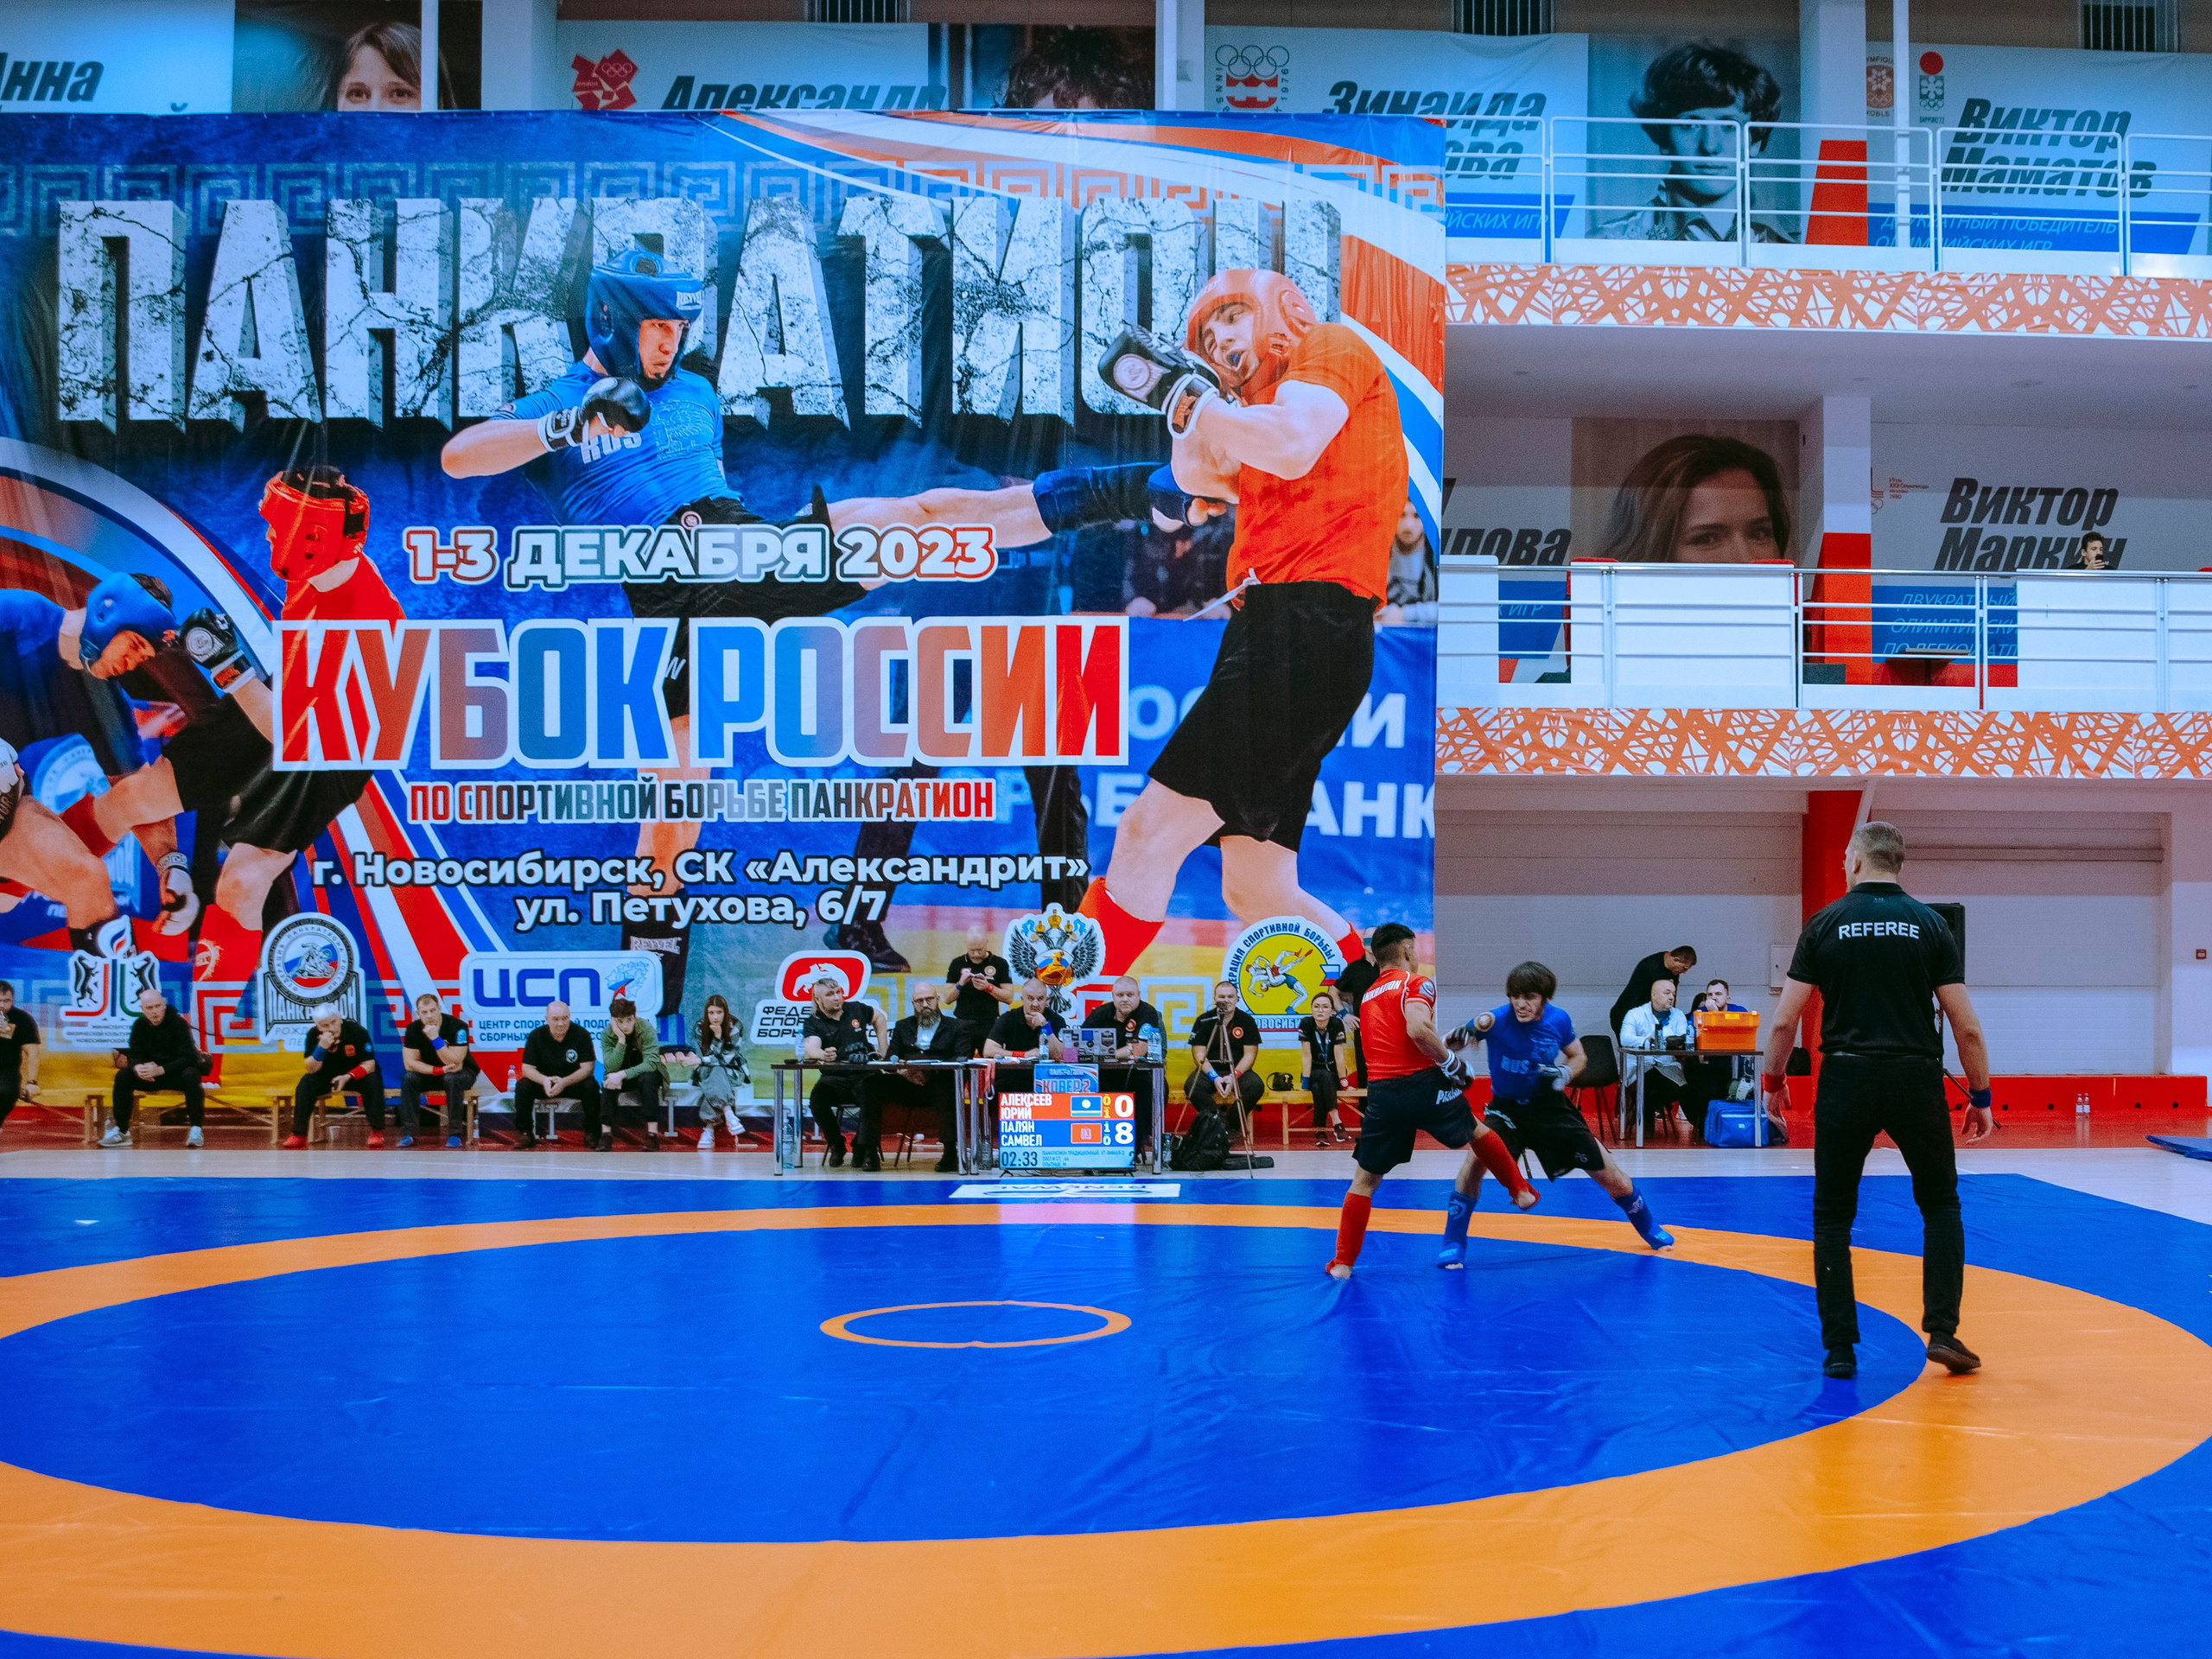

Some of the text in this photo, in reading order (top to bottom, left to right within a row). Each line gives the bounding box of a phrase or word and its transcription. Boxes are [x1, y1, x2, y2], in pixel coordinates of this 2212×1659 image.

[1953, 98, 2132, 154] Виктор
[1941, 146, 2157, 198] Маматов
[1940, 478, 2119, 531] Виктор
[405, 525, 996, 588] 1-3 ДЕКАБРЯ 2023
[278, 623, 668, 765] КУБОК
[696, 623, 1124, 763] РОССИИ
[410, 785, 451, 821] ПО
[458, 776, 658, 820] СПОРТИВНОЙ
[664, 782, 786, 820] БОРЬБЕ
[791, 781, 994, 819] ПАНКРАТИОН
[313, 850, 1089, 891] г. Новосибирск, СК «Александрит»
[516, 887, 887, 931] ул. Петухова, 6/7
[1838, 921, 1920, 940] REFEREE
[473, 968, 601, 1007] ЦСП
[479, 1020, 512, 1031] ЦЕНТР
[1000, 1093, 1052, 1107] АЛЕКСЕЕВ
[1001, 1105, 1032, 1120] ЮРИЙ
[1114, 1095, 1135, 1118] 0
[1001, 1121, 1035, 1133] ПАЛЯН
[1001, 1134, 1043, 1147] САМВЕЛ
[1114, 1122, 1135, 1145] 8
[1001, 1151, 1038, 1166] 02:33
